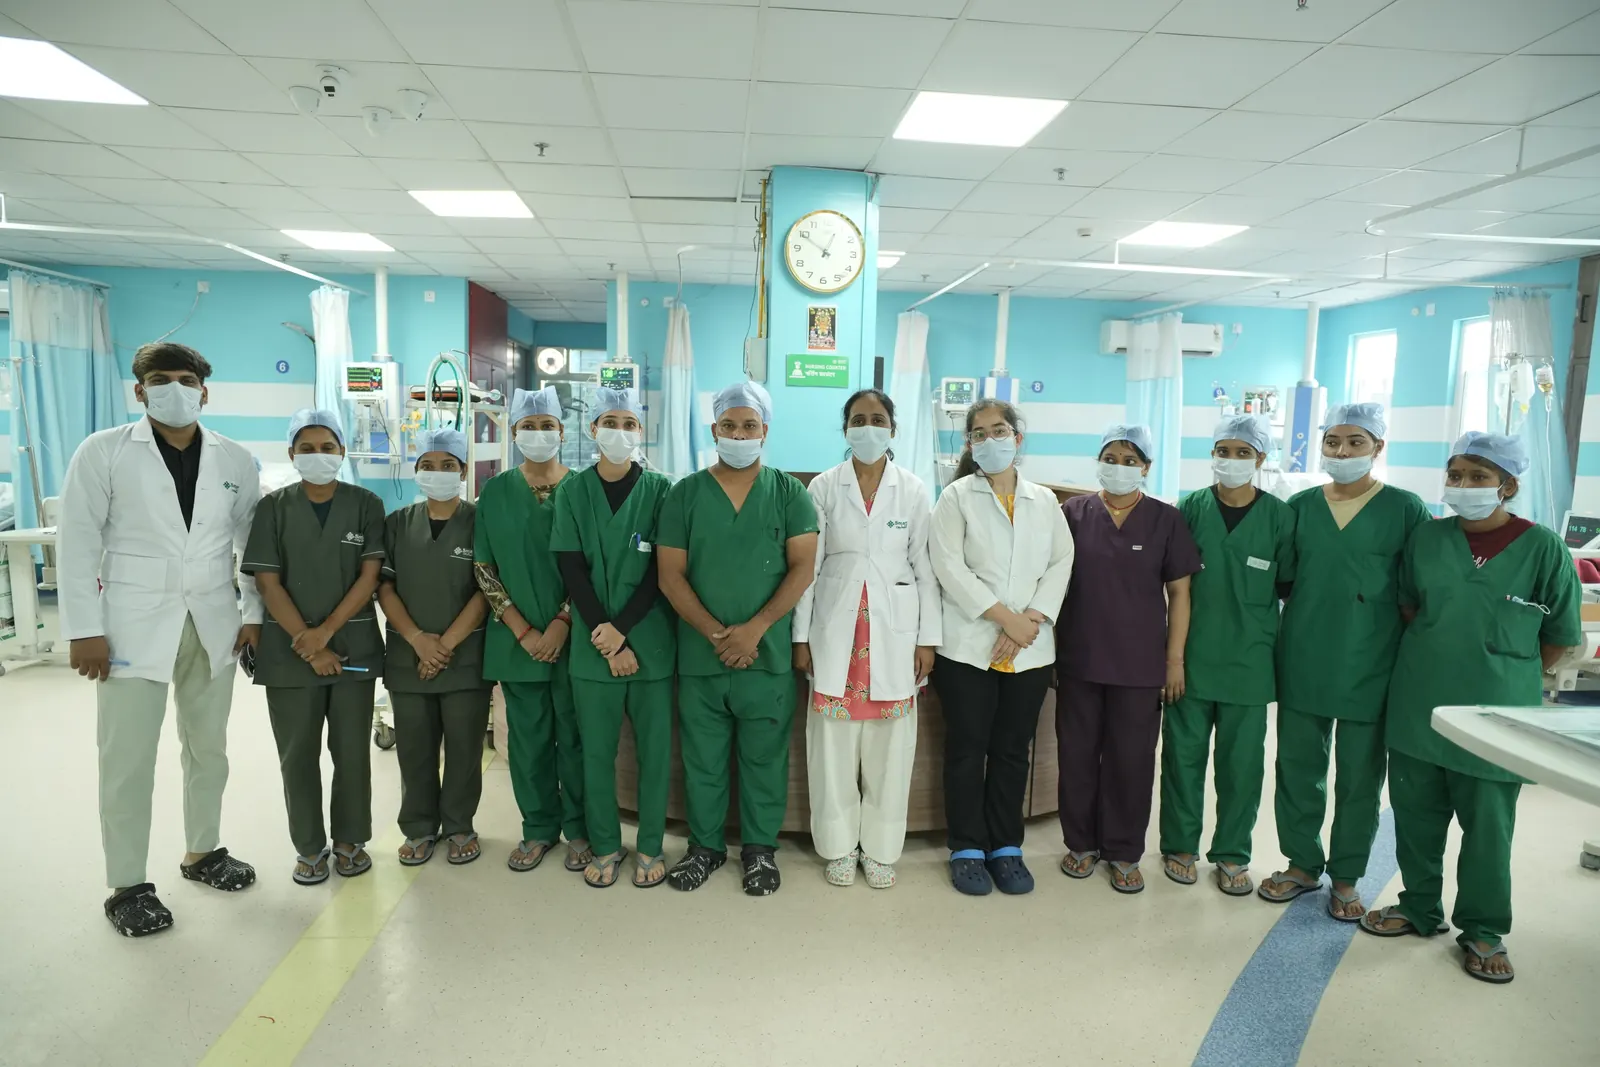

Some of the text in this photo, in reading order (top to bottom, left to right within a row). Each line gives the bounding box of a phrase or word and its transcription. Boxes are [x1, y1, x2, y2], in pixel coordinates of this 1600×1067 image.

[799, 230, 810, 238] 10
[793, 244, 802, 252] 9
[796, 259, 804, 267] 8
[805, 271, 814, 279] 7
[833, 274, 842, 282] 5
[819, 276, 827, 284] 6
[279, 362, 286, 372] 6
